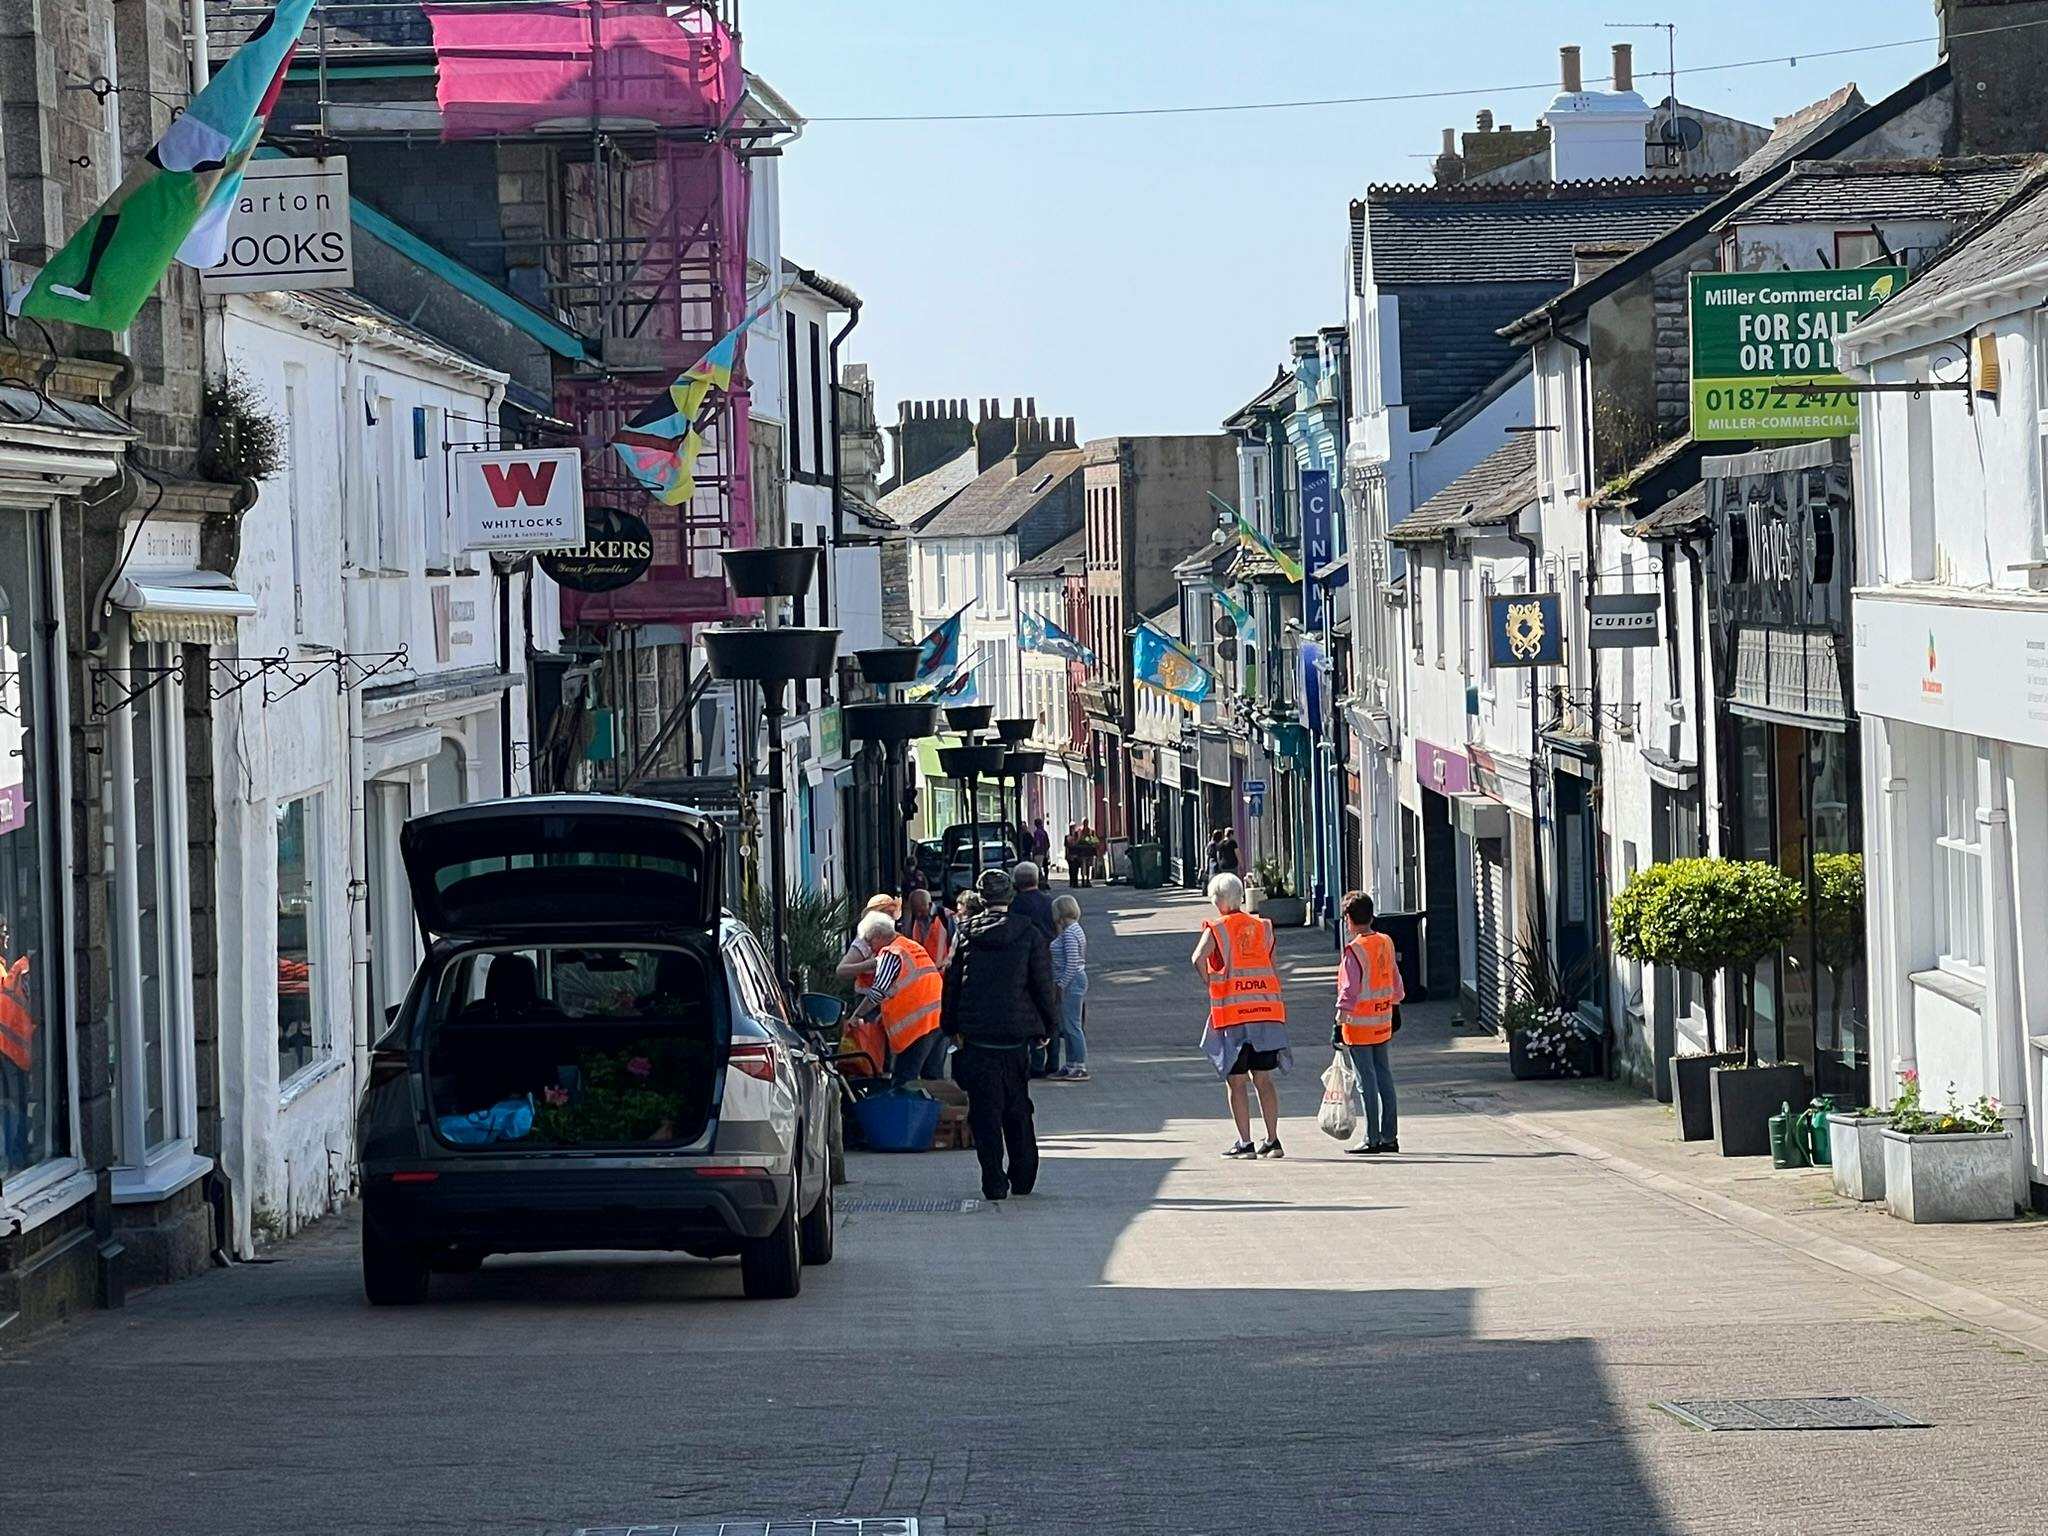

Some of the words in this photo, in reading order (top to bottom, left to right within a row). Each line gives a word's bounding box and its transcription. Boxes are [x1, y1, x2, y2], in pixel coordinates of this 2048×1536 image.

[240, 192, 330, 213] arton
[1705, 288, 1756, 306] Miller
[1759, 285, 1863, 304] Commercial
[1739, 313, 1790, 342] FOR
[1740, 344, 1775, 371] OR
[1780, 343, 1811, 369] TO
[1706, 388, 1788, 411] 01872
[481, 518, 563, 529] WHITLOCKS
[1594, 616, 1653, 626] CURIOS
[1235, 980, 1267, 991] FLORA
